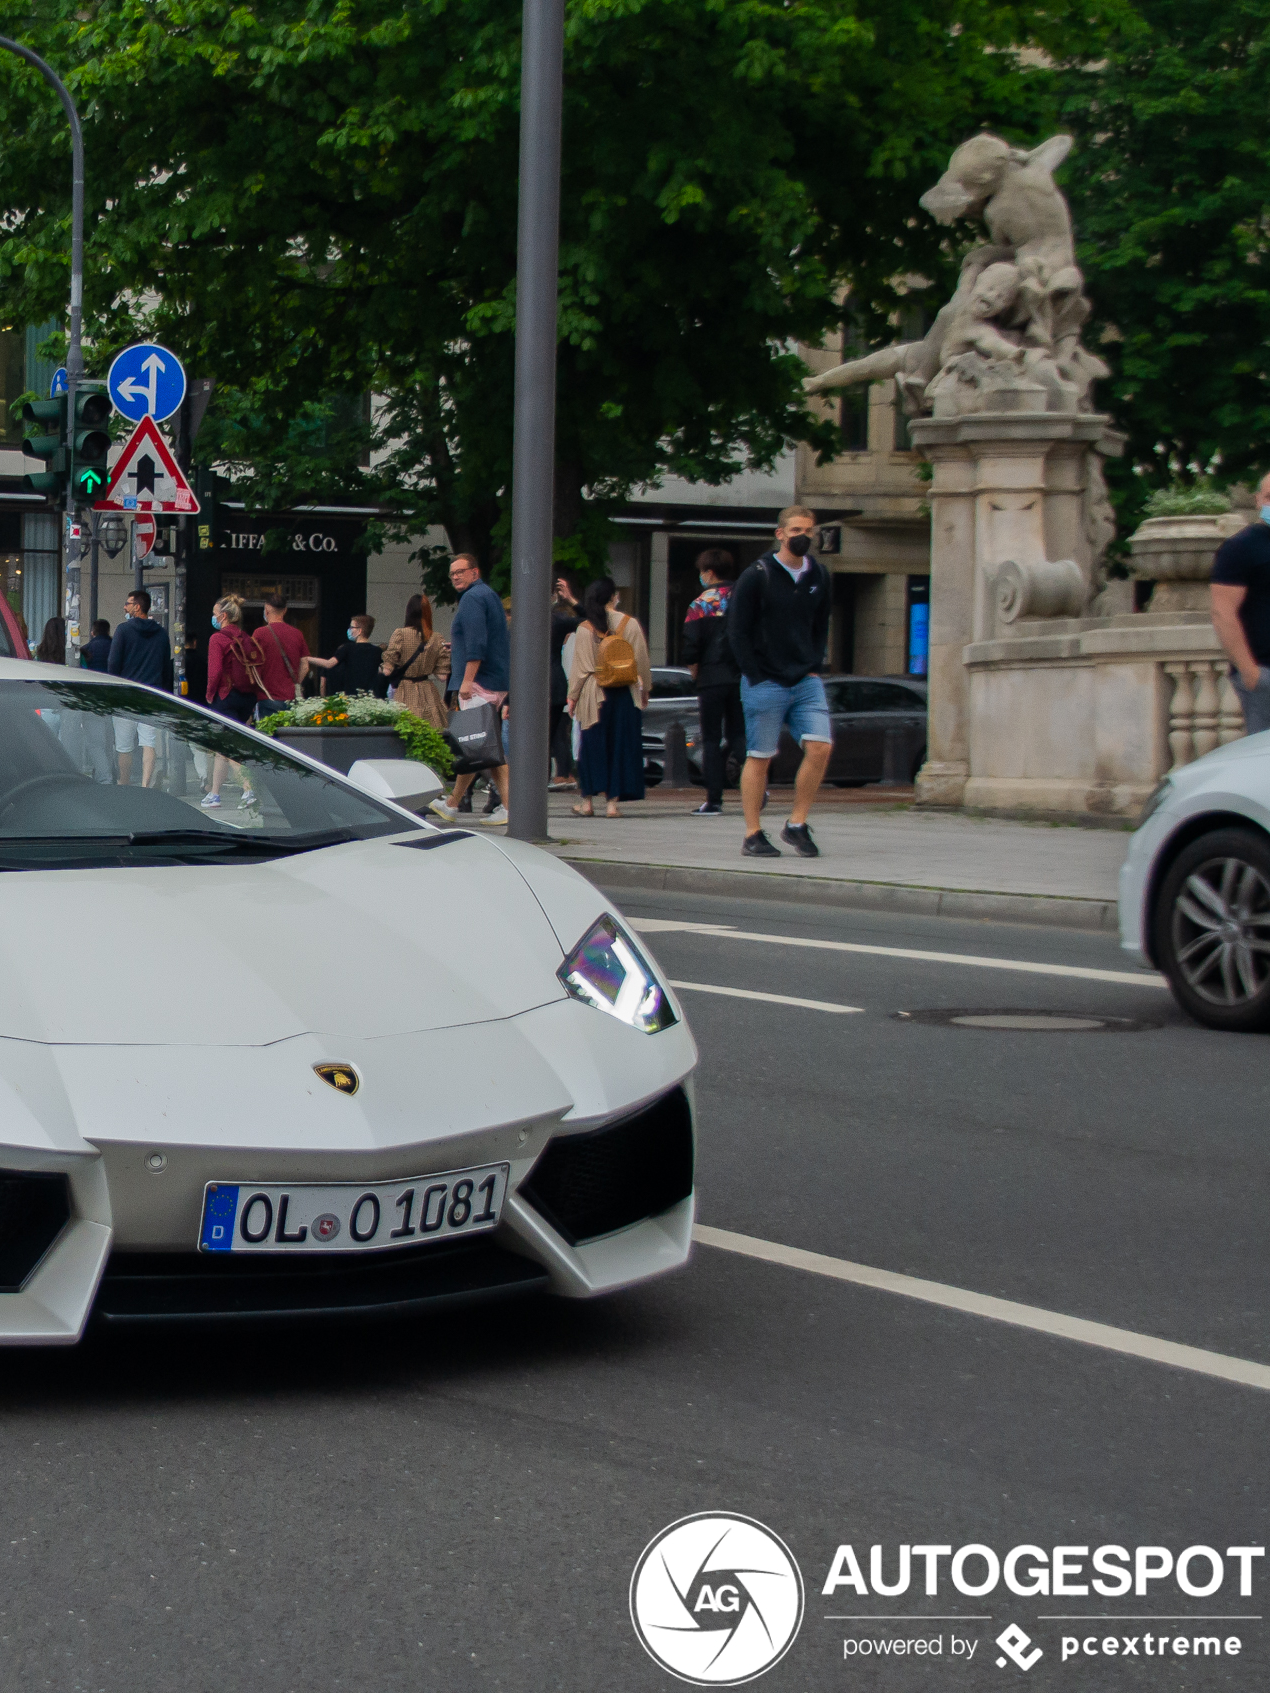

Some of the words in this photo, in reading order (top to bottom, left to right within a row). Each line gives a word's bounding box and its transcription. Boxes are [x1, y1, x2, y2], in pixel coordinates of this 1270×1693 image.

[219, 529, 292, 549] IFFA
[239, 1192, 308, 1243] OL
[390, 1173, 497, 1239] 1081
[211, 1225, 224, 1239] D
